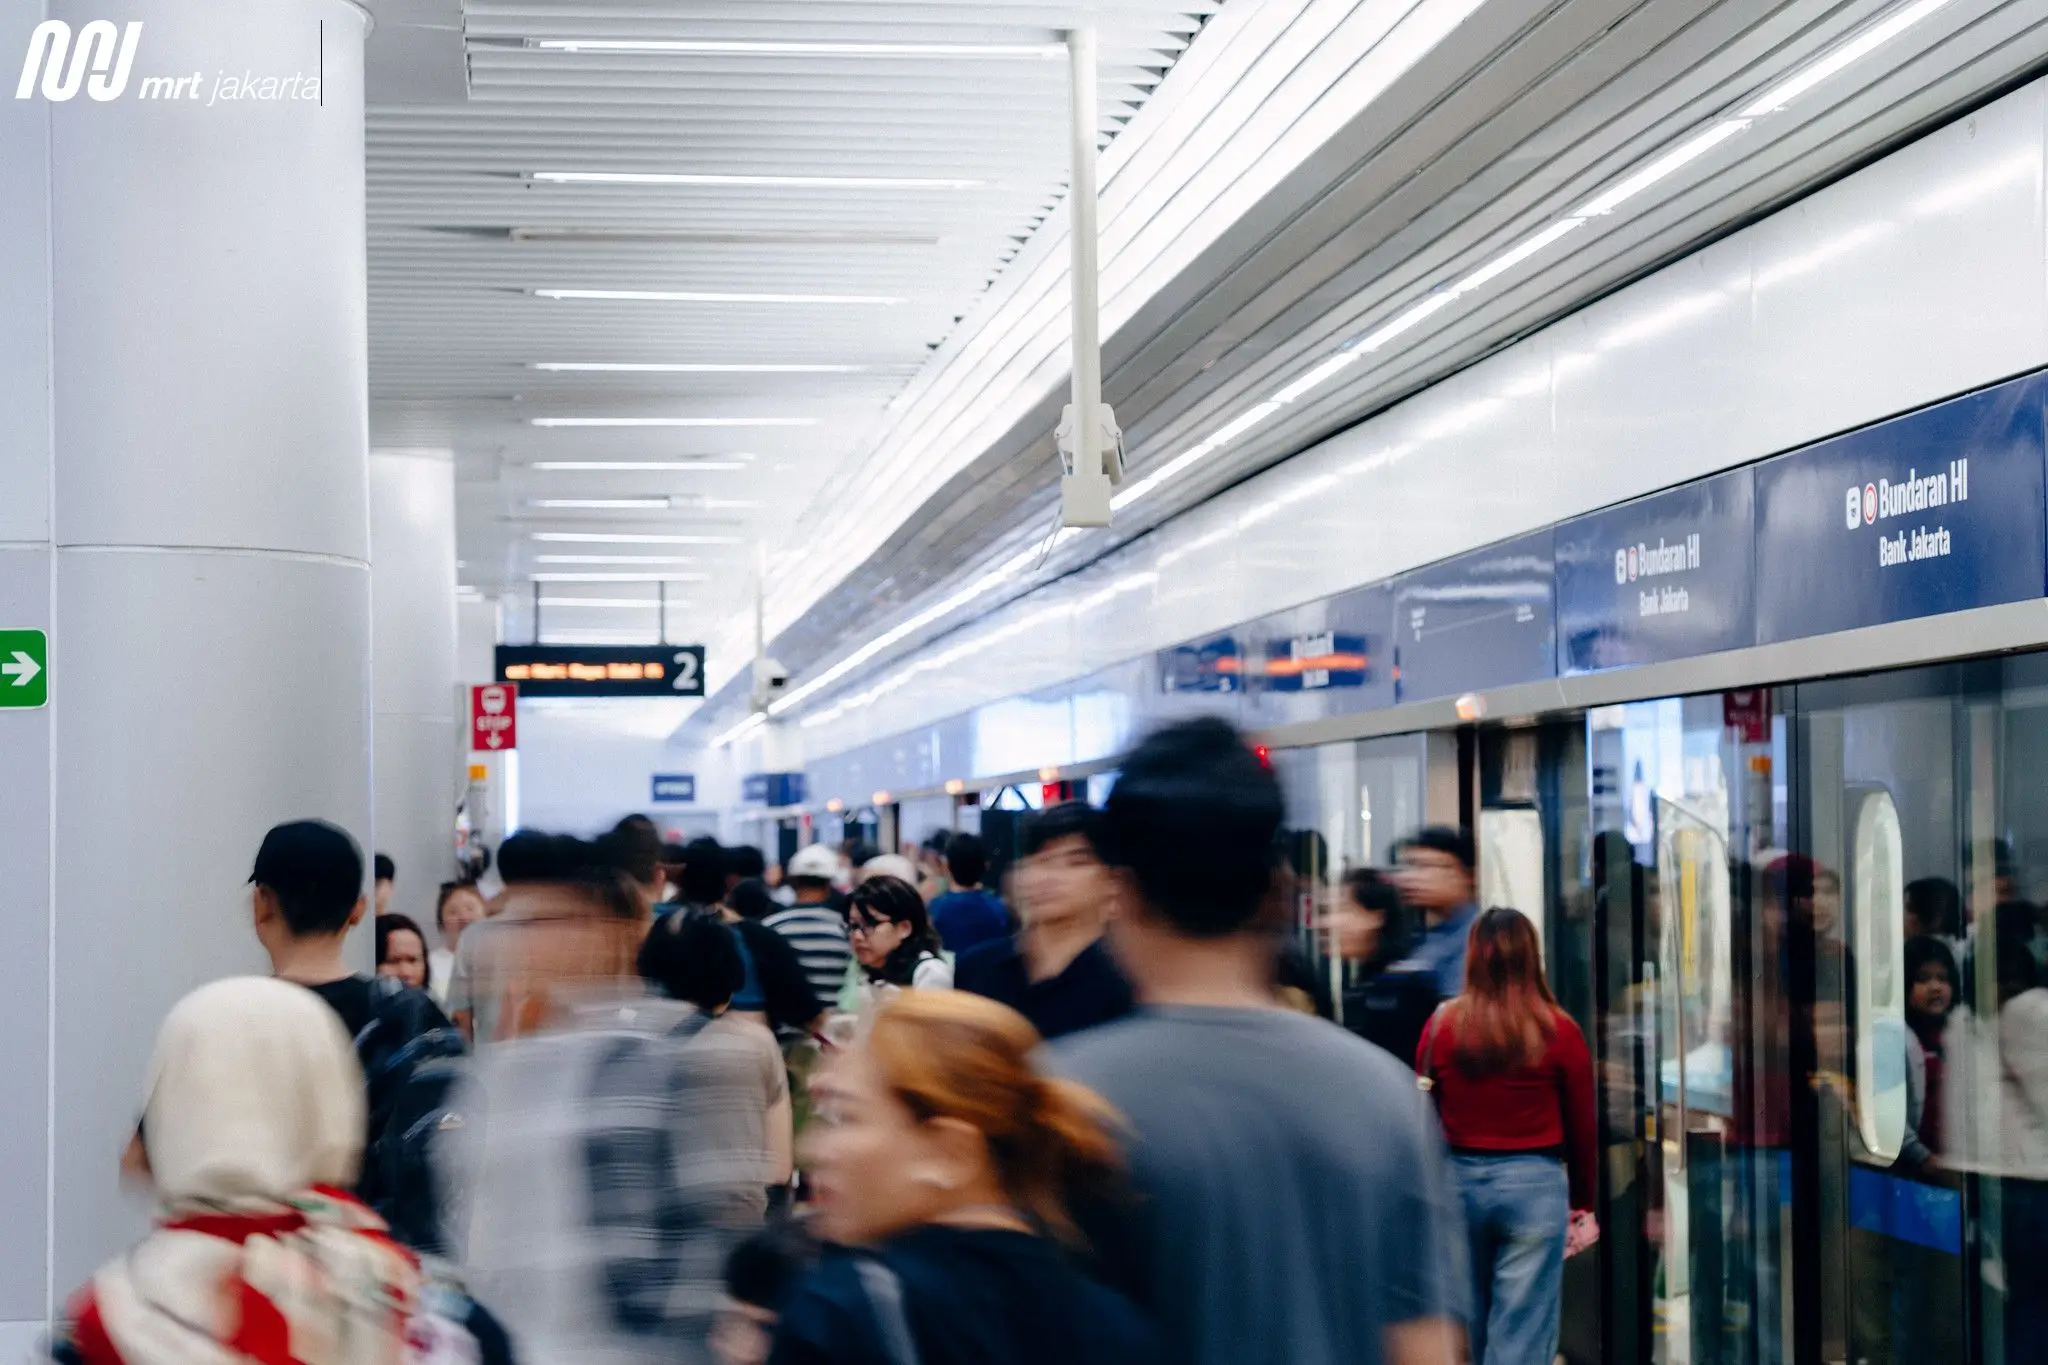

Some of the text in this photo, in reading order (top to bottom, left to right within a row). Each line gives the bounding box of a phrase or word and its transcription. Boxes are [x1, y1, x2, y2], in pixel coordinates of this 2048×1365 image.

[1879, 457, 1968, 519] Bundaran HI
[1638, 533, 1700, 576] Bundaran HI
[1879, 525, 1951, 567] Bank Jakarta
[672, 651, 700, 690] 2
